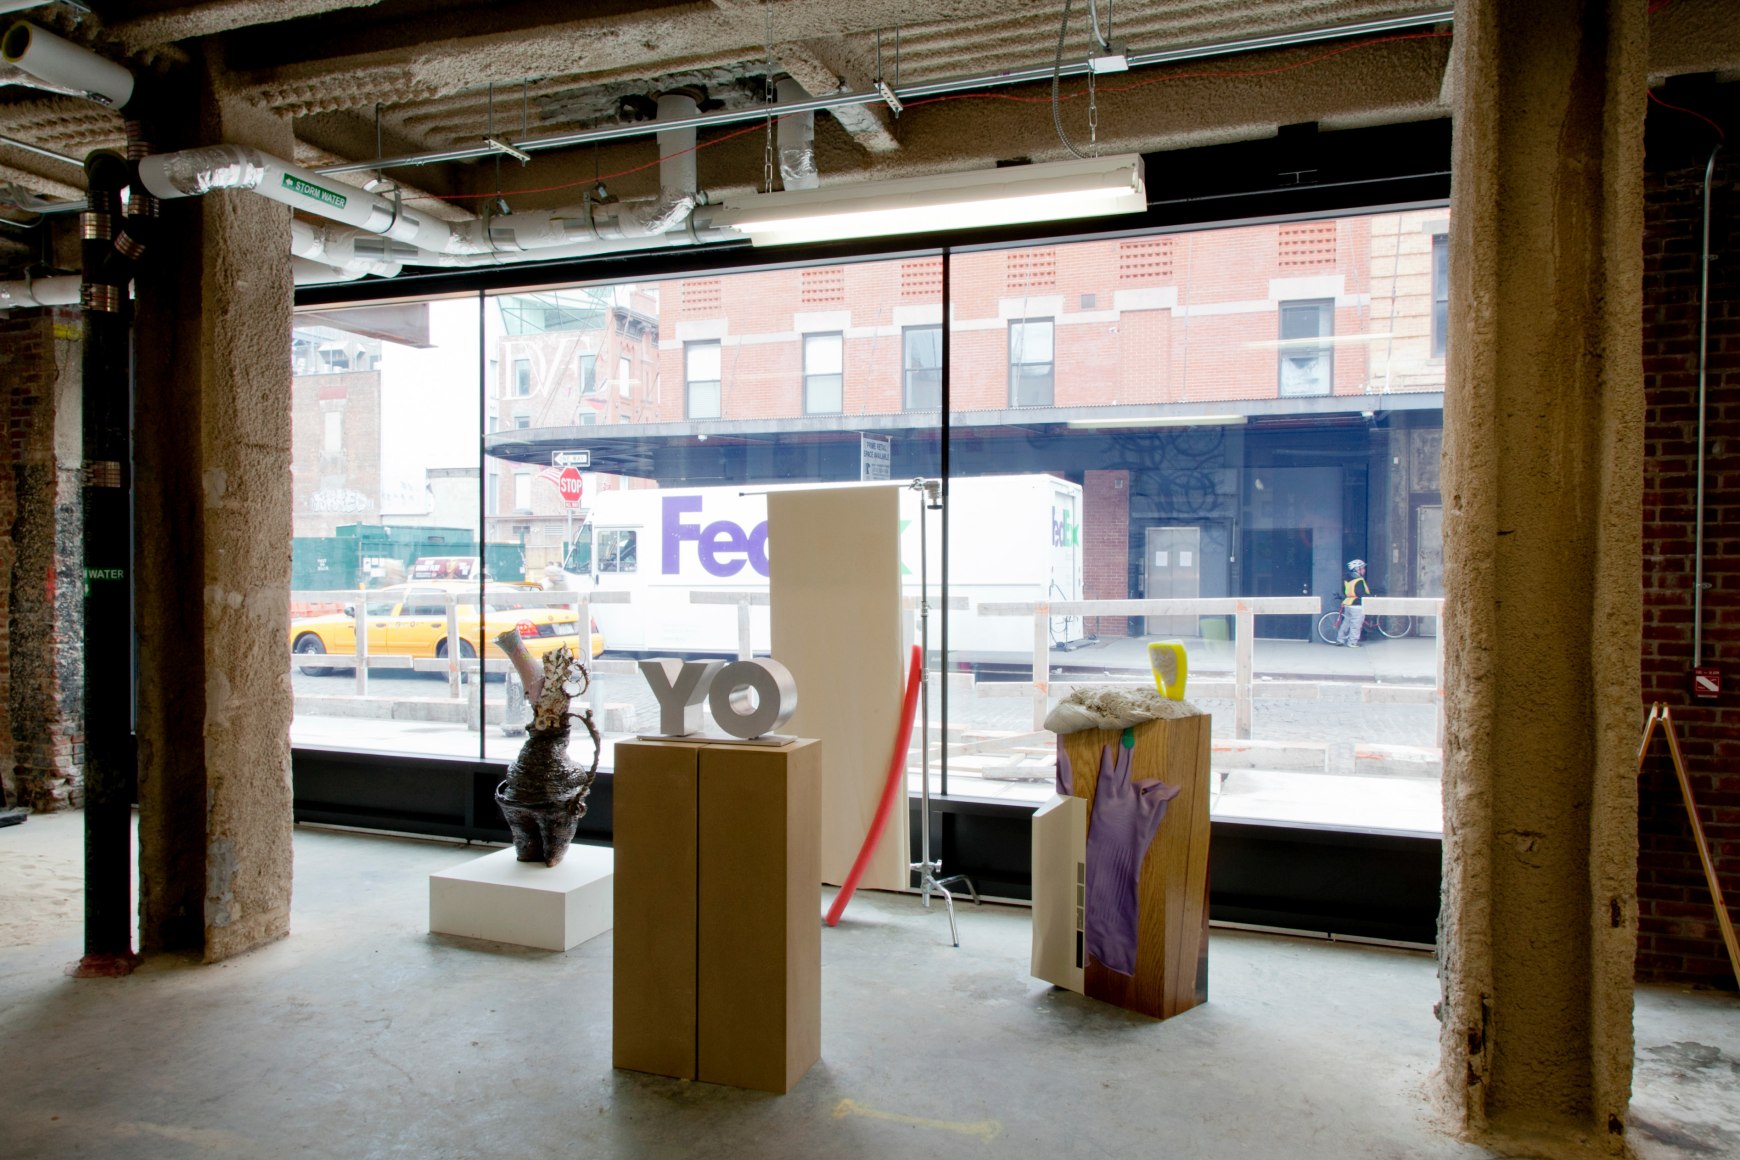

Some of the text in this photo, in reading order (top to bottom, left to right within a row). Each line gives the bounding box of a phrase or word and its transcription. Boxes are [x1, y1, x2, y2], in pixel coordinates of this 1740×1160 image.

[295, 181, 345, 207] STORM WATER
[560, 477, 582, 494] STOP
[88, 569, 124, 579] WATER
[638, 658, 798, 739] YO
